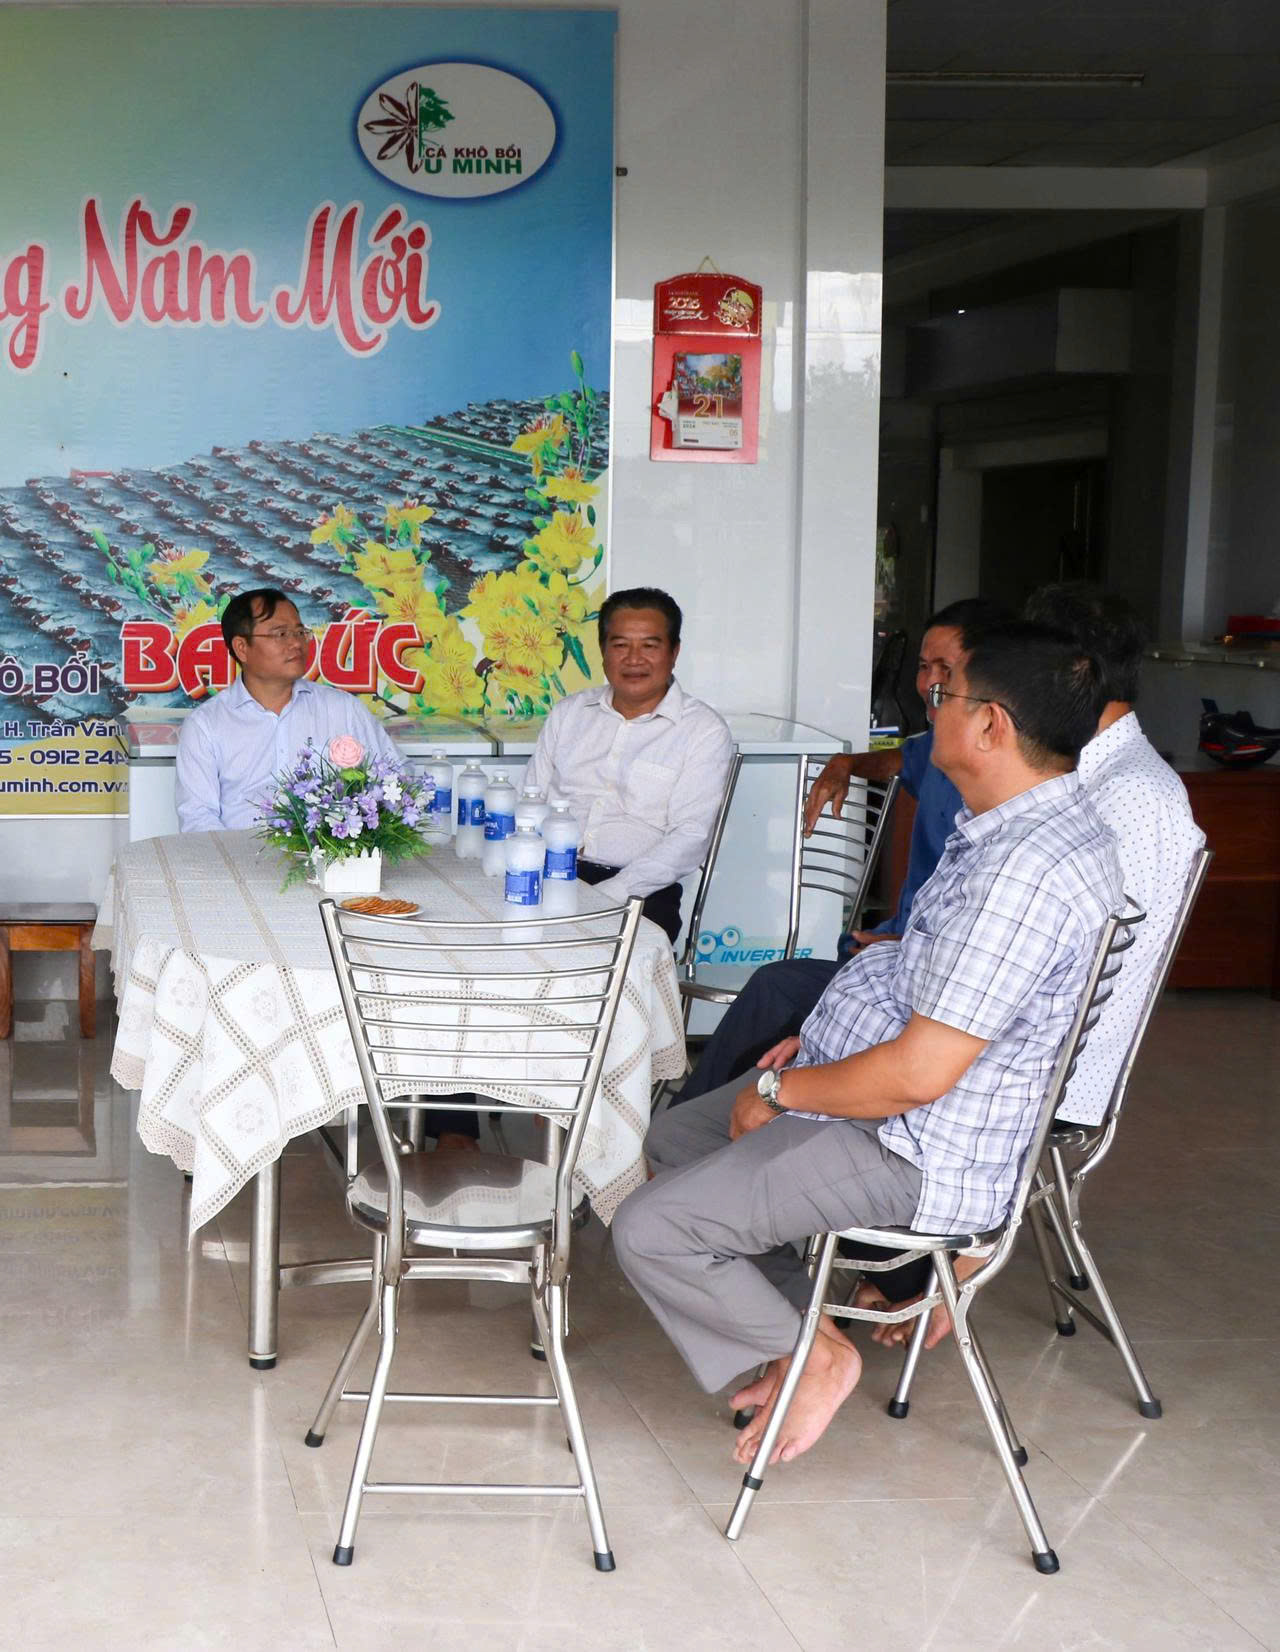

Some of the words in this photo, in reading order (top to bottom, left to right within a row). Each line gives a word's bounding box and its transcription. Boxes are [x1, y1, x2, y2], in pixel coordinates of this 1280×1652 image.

[426, 144, 447, 158] CÁ
[455, 144, 488, 158] KHÔ
[424, 159, 442, 174] U
[453, 159, 522, 174] MINH
[65, 198, 264, 325] Năm
[276, 201, 436, 355] Mới
[693, 394, 724, 418] 21
[34, 651, 100, 694] BỔI
[119, 621, 237, 700] BA
[298, 608, 424, 694] ỨC
[5, 722, 23, 736] H.
[28, 719, 75, 736] Trần
[30, 750, 80, 765] 0912
